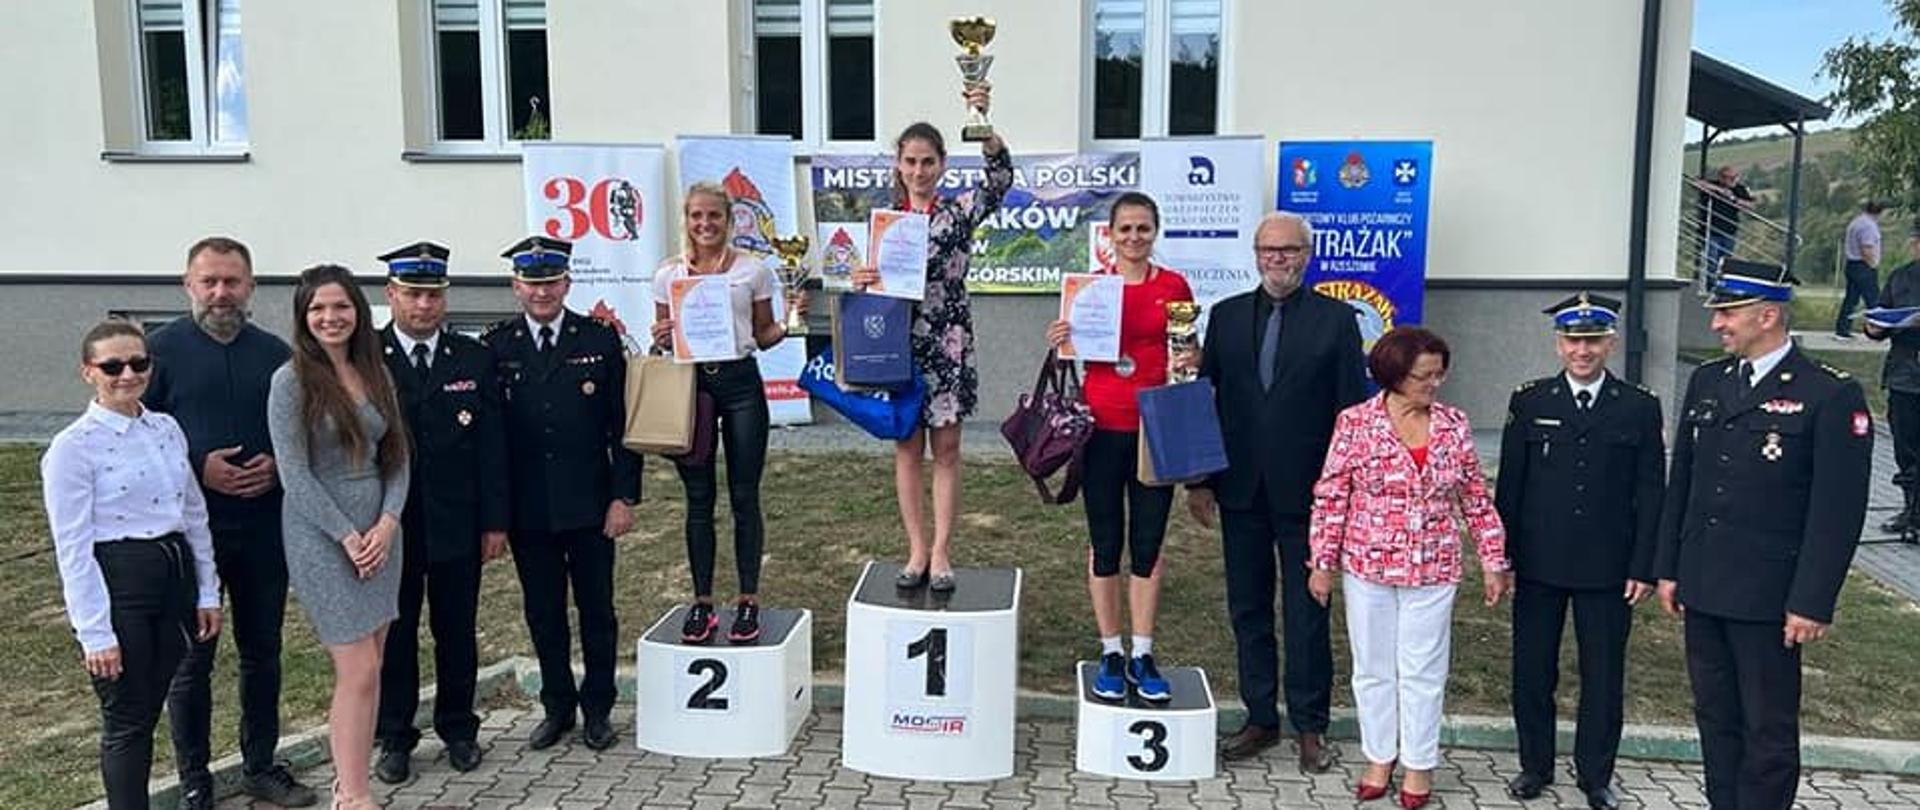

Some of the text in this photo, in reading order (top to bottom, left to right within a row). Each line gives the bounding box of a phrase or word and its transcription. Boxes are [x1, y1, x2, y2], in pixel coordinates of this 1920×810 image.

[1036, 166, 1136, 187] POLSKI
[544, 177, 643, 241] 30
[978, 201, 1081, 229] AKÓW
[1311, 225, 1413, 258] TRAŻAK”
[686, 657, 729, 710] 2
[907, 628, 947, 695] 1
[1126, 719, 1169, 772] 3
